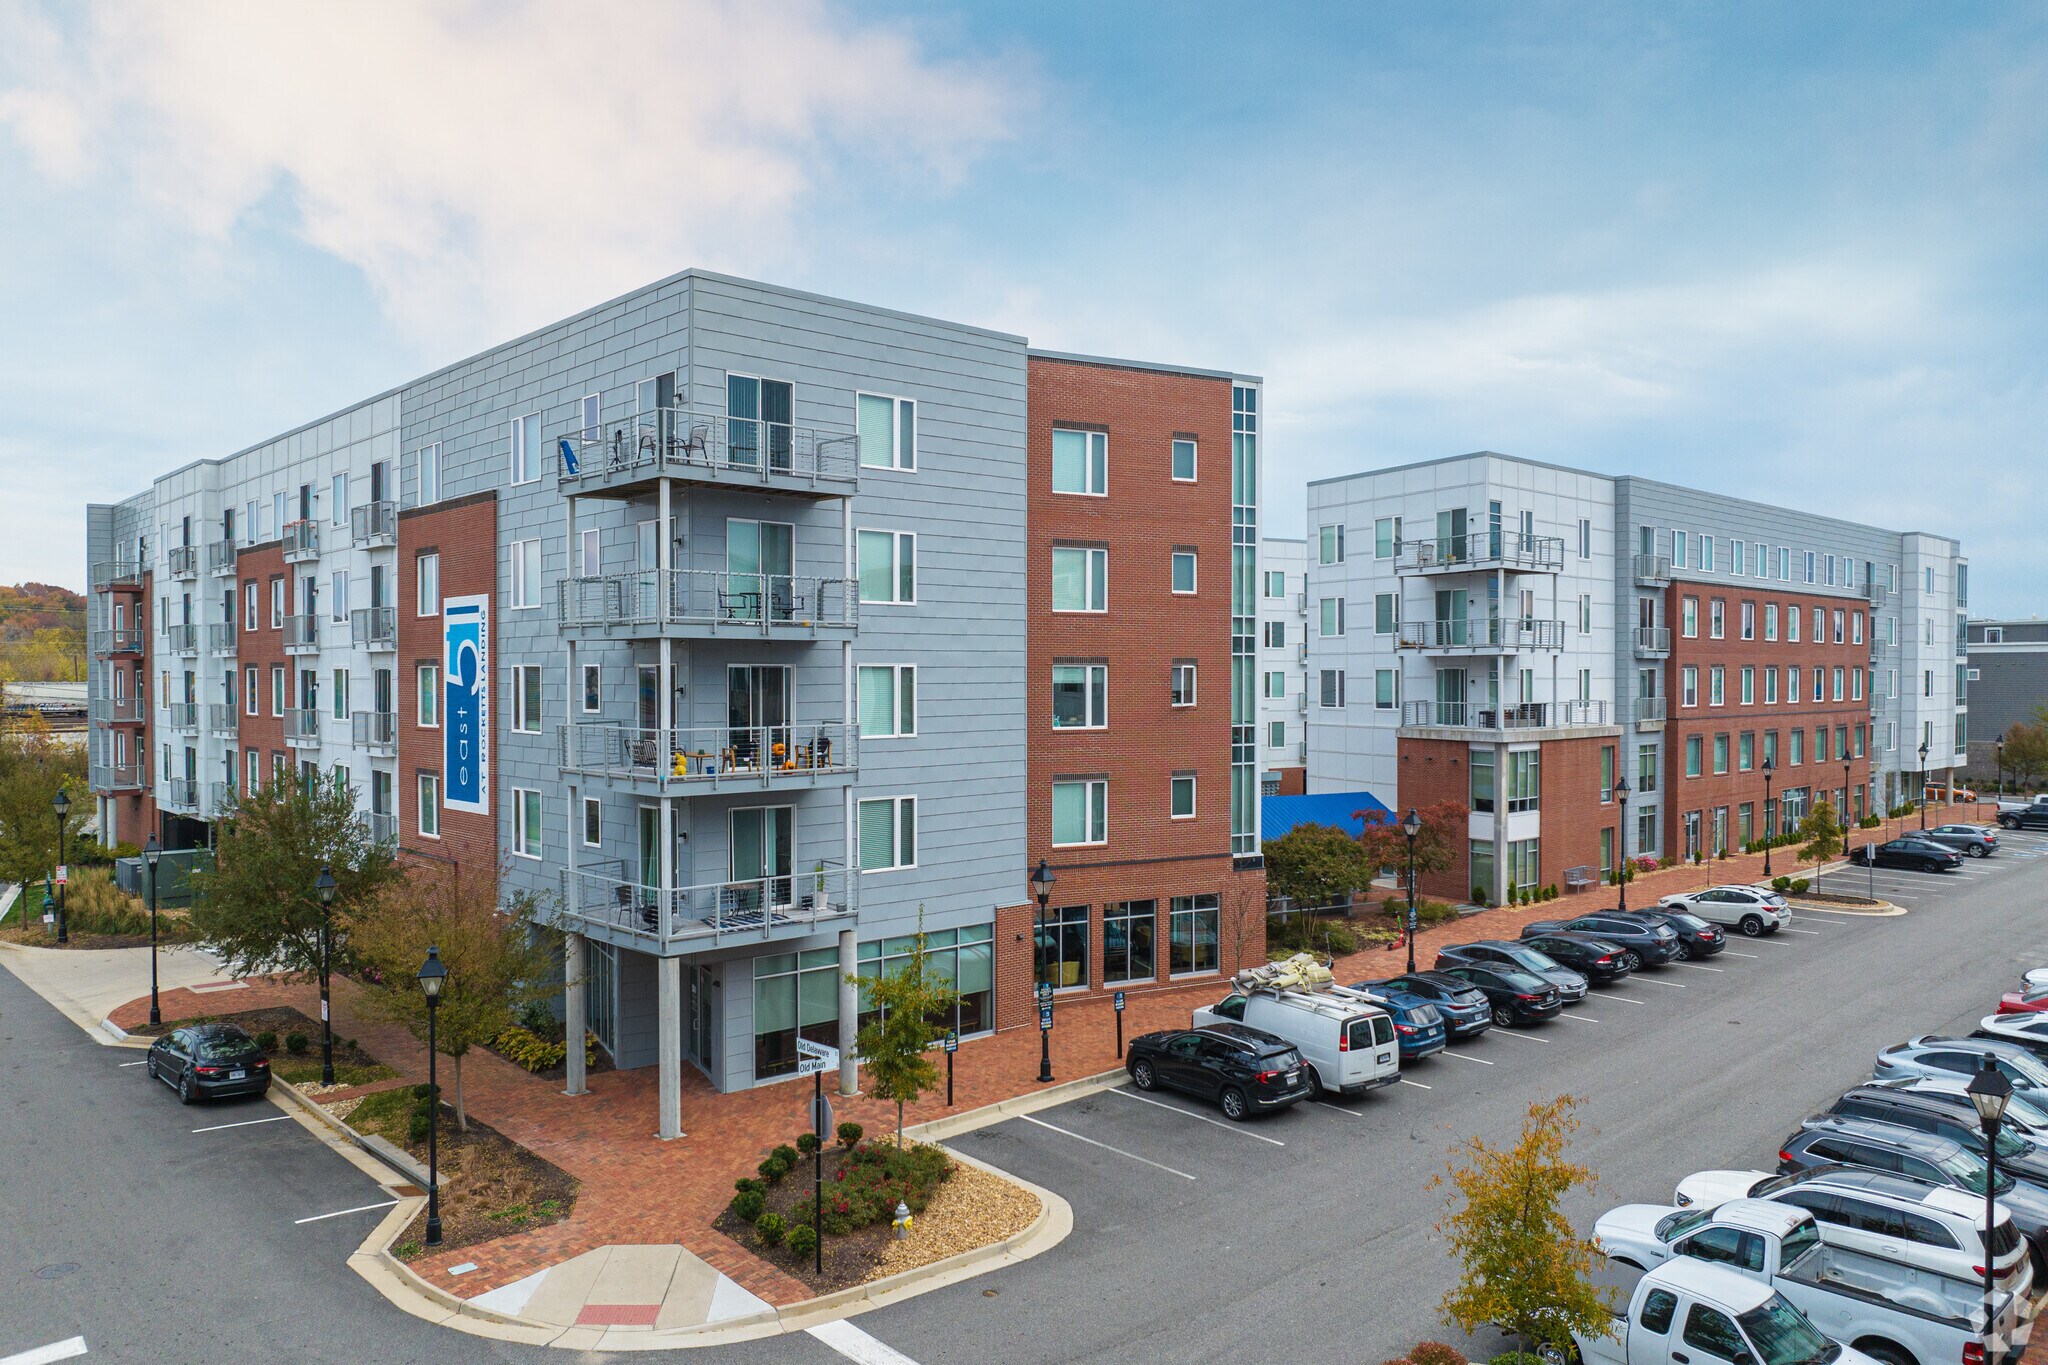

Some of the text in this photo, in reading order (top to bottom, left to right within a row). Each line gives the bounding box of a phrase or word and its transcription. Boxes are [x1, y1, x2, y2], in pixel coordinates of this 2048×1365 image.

[457, 706, 469, 786] east
[481, 771, 486, 794] AT
[798, 1041, 806, 1050] Old
[807, 1043, 829, 1057] Delaware
[800, 1063, 810, 1073] Old
[811, 1061, 826, 1071] Main
